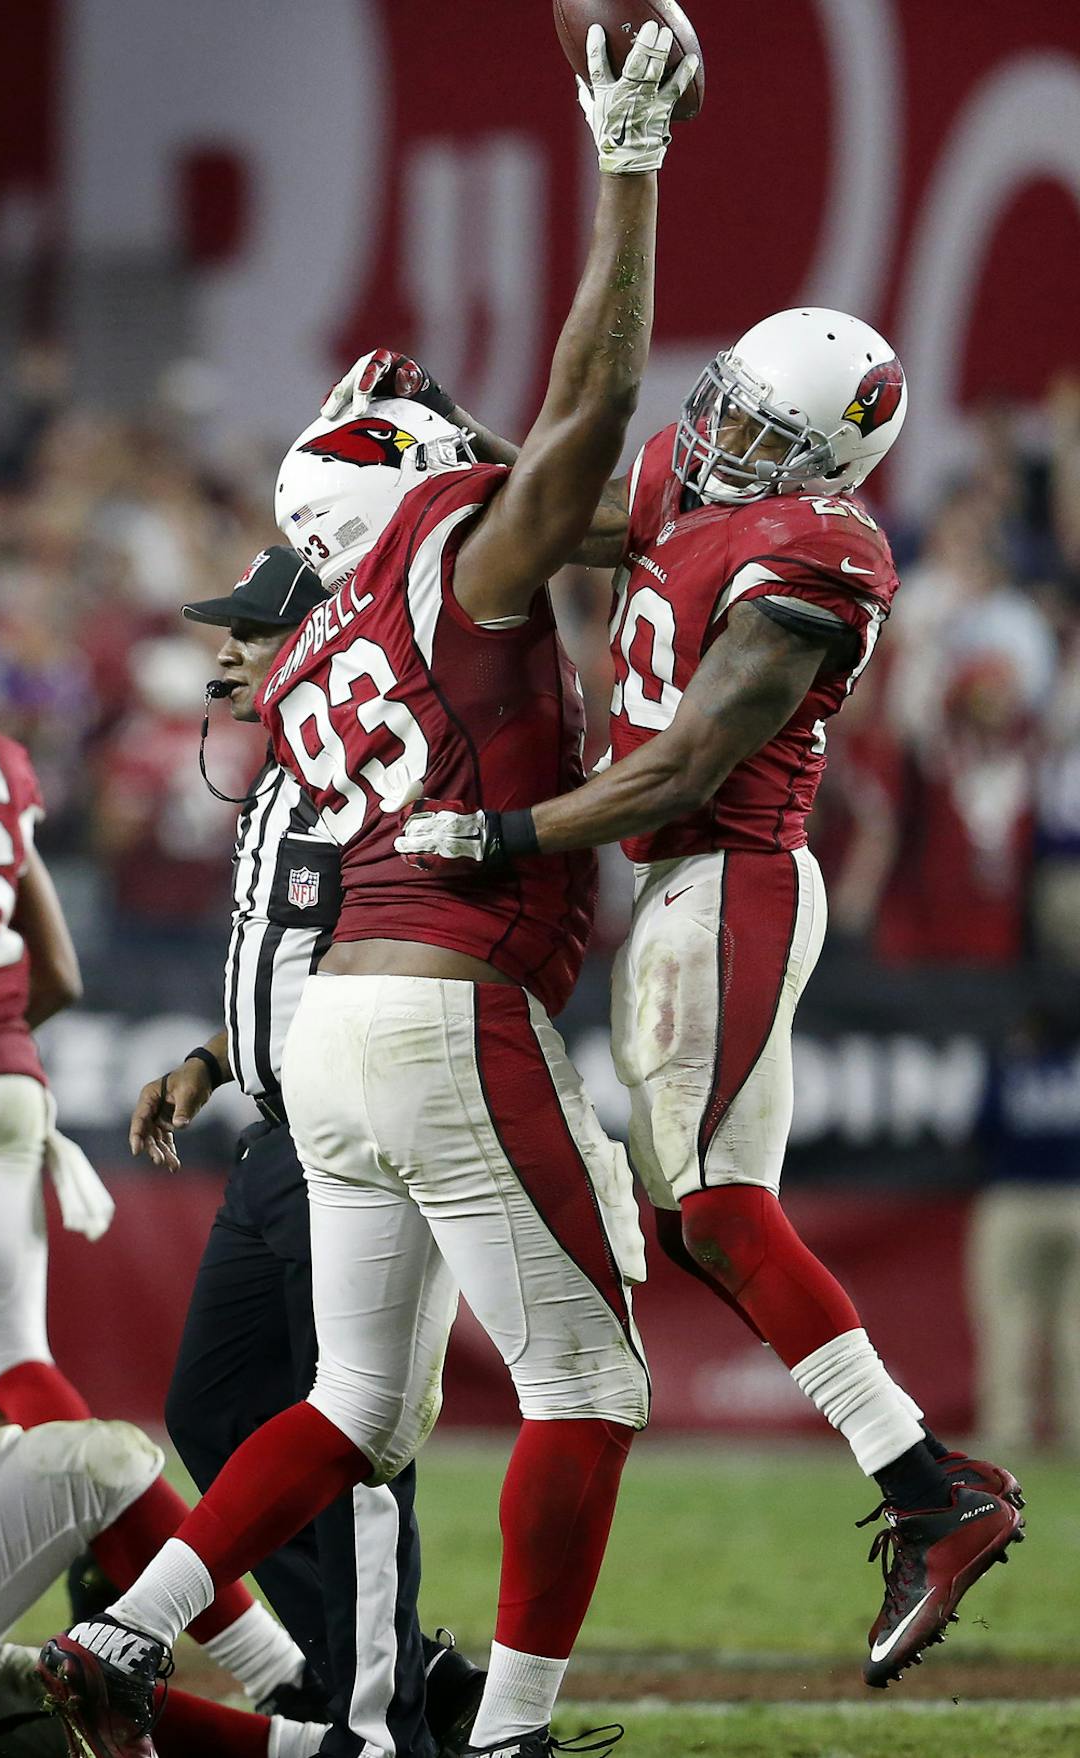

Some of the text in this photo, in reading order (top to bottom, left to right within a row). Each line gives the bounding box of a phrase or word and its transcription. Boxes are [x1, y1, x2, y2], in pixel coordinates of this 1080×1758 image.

[263, 576, 374, 704] CAMPBELL
[610, 586, 684, 732] 0
[278, 637, 428, 846] 93
[291, 884, 315, 904] NFL
[959, 1502, 995, 1521] ALPHA
[67, 1622, 154, 1675] NIKE
